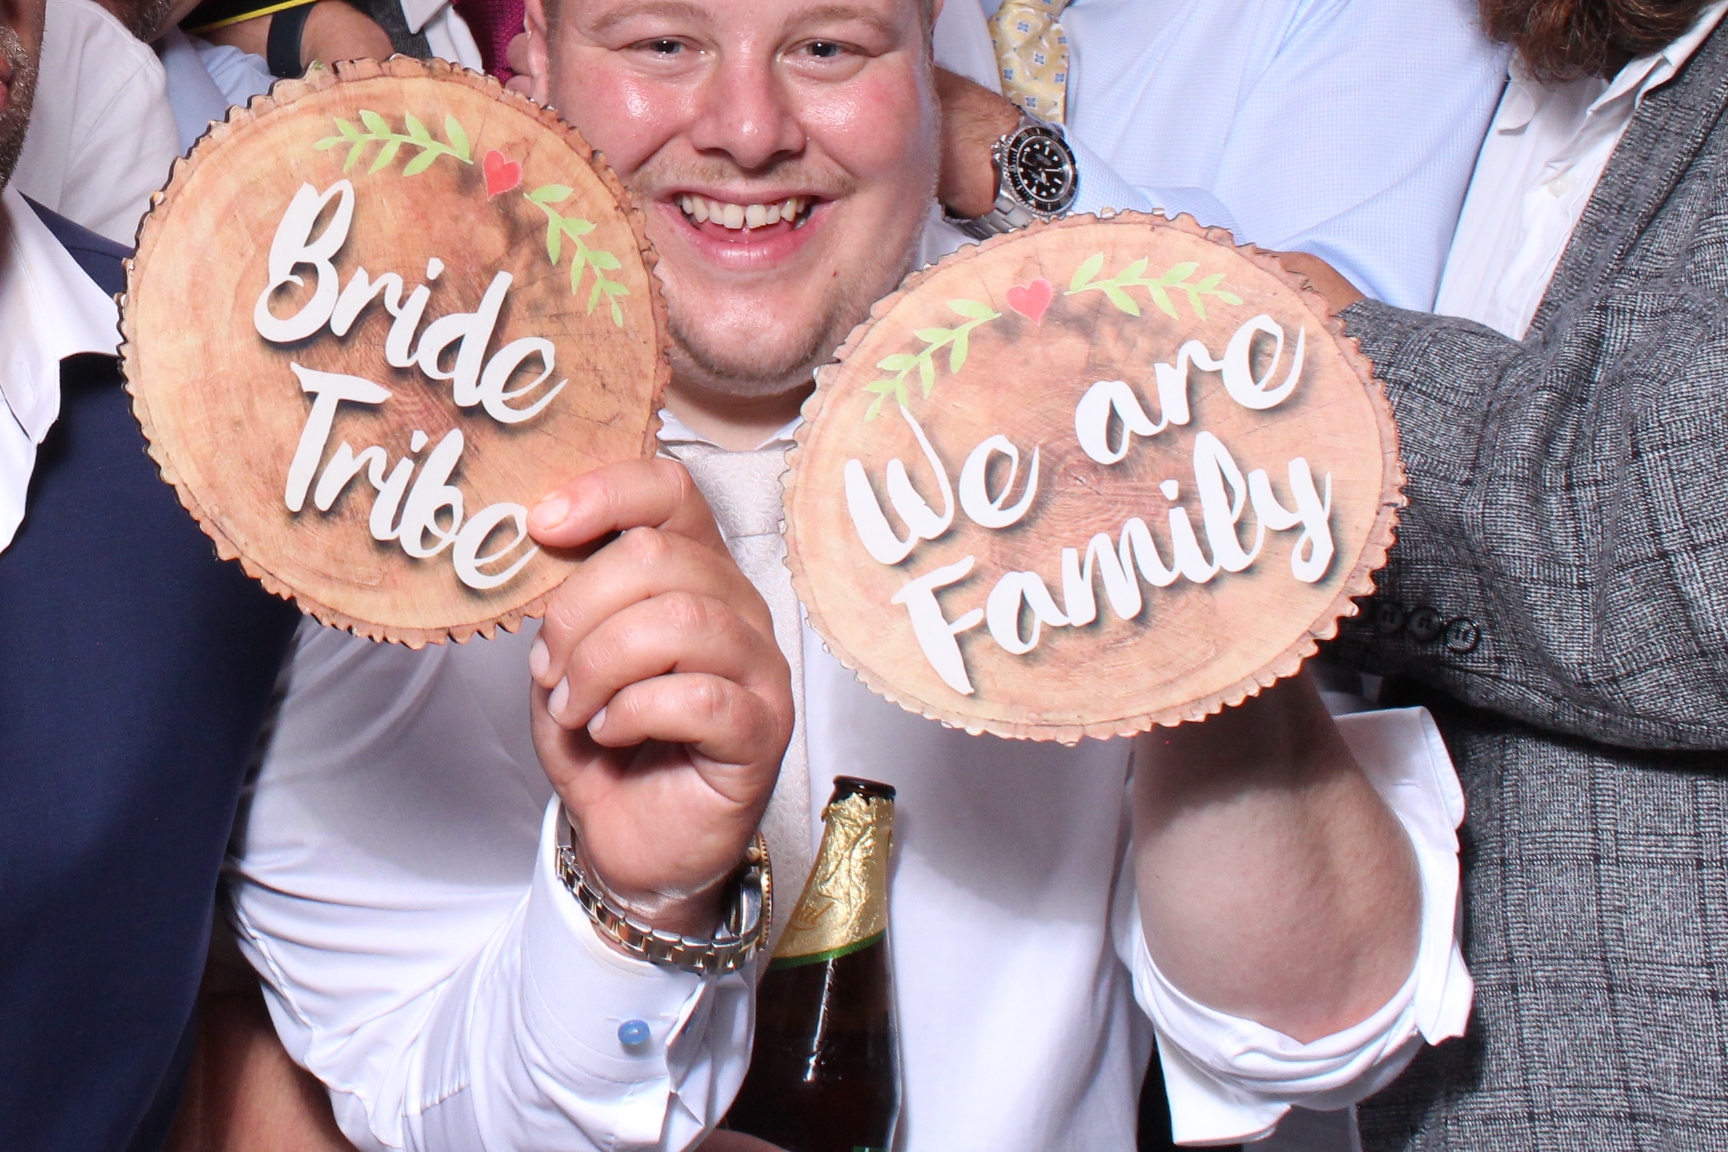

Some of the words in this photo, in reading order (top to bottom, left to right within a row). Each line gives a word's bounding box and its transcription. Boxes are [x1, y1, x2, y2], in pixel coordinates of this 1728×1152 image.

[253, 178, 568, 424] Bride
[284, 362, 540, 590] Tribe
[844, 404, 1040, 565] We
[1075, 314, 1305, 465] are
[891, 431, 1332, 695] Family
